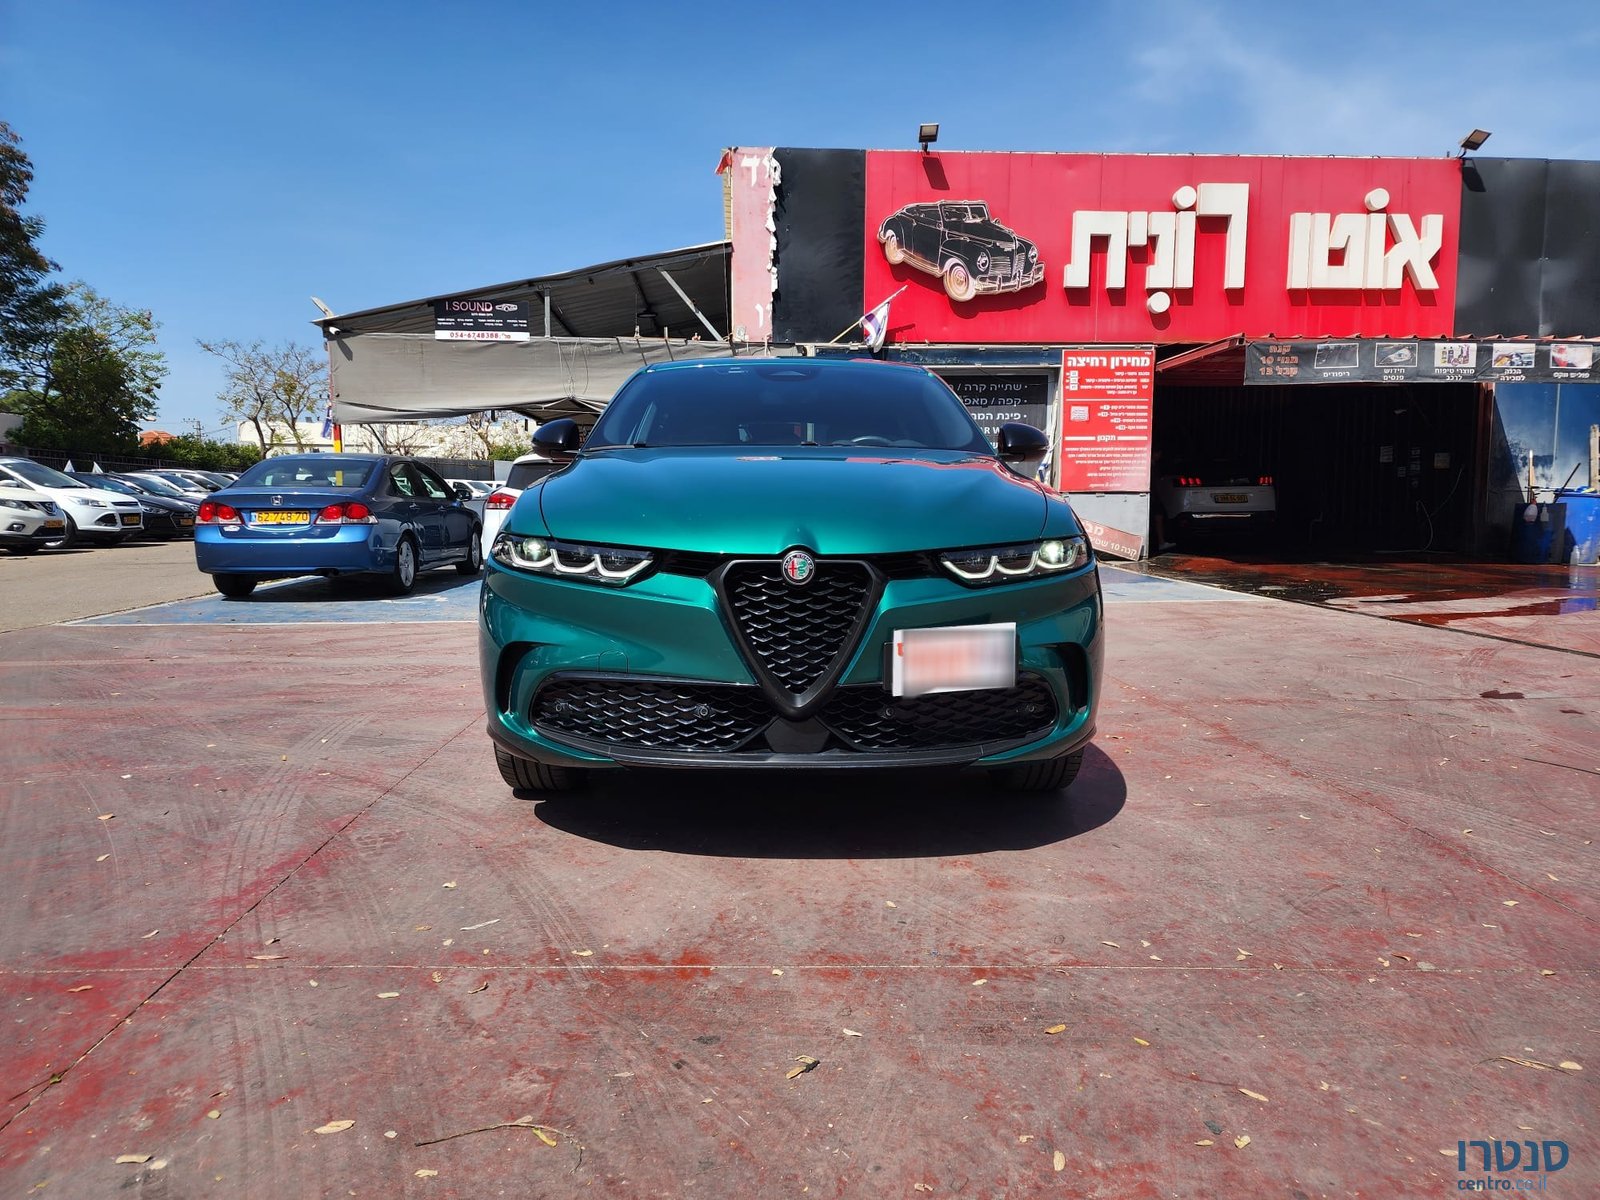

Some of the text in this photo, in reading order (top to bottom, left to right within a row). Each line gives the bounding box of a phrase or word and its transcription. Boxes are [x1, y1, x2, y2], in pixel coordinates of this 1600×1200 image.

[1067, 356, 1150, 370] מחירון רחיצה
[964, 383, 987, 393] קרה
[989, 383, 1022, 391] שתייה
[962, 397, 988, 405] מאפ
[998, 398, 1021, 407] קפה
[996, 412, 1021, 420] פינת
